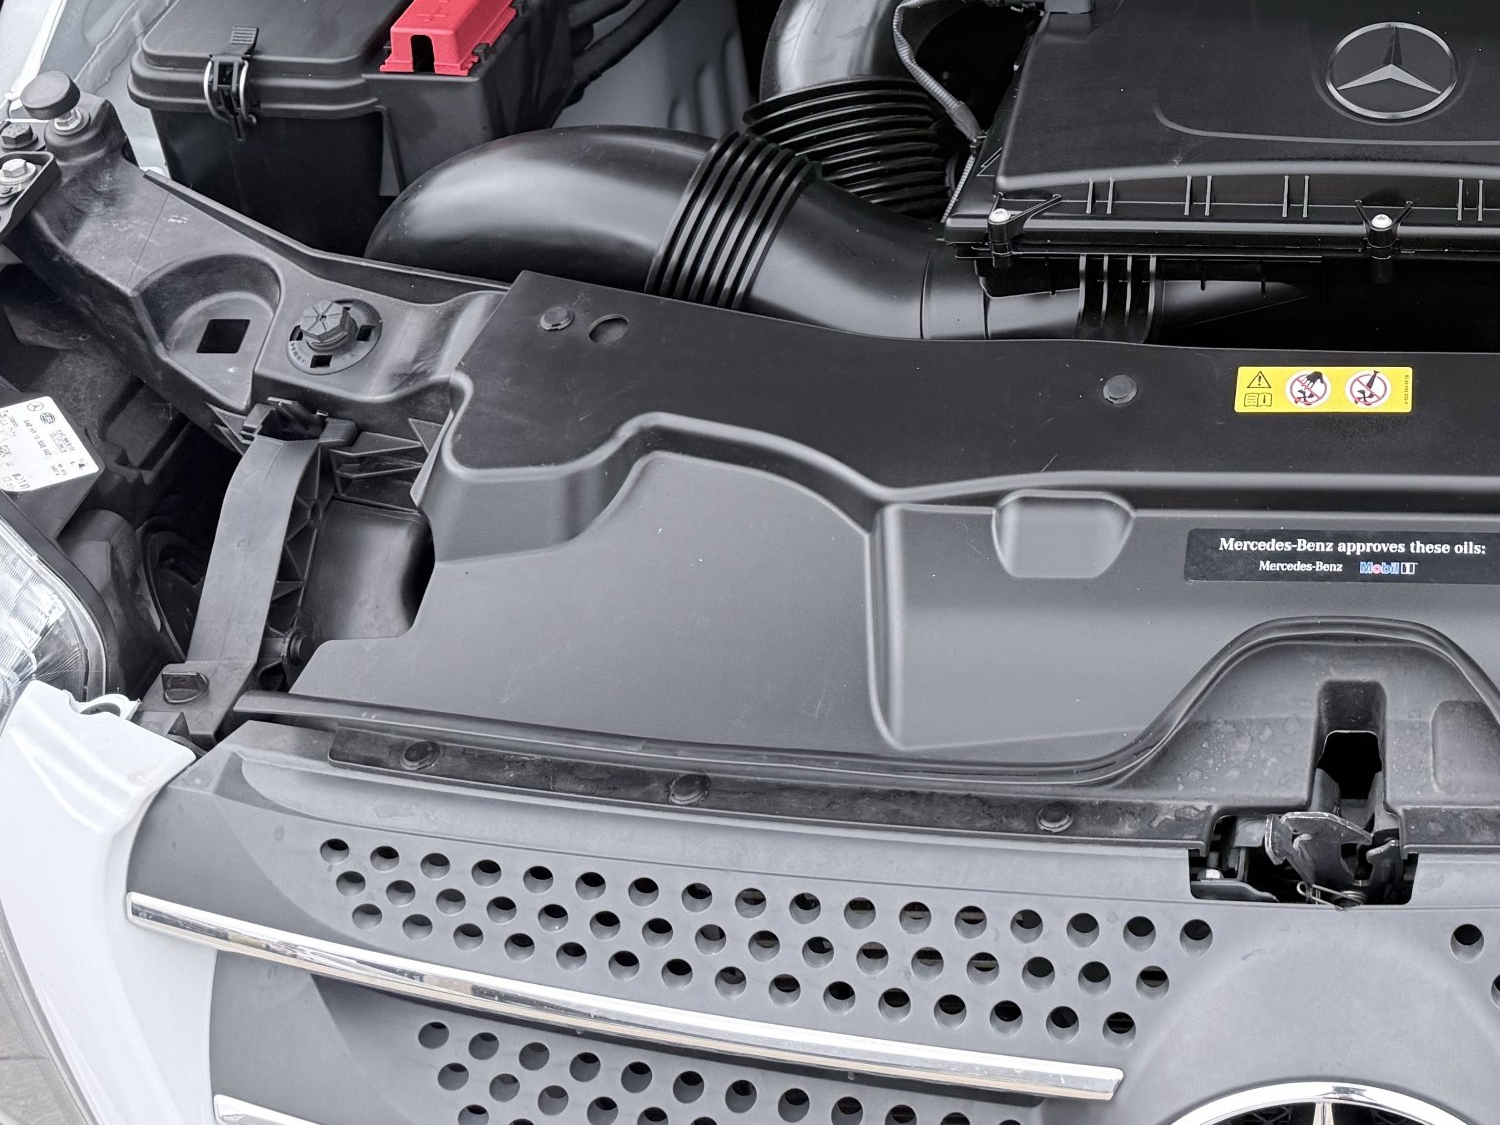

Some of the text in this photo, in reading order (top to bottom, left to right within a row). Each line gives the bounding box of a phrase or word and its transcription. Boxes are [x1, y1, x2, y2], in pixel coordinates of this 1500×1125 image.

[1220, 538, 1485, 555] Mercedes-Benz approves these oils:
[1259, 561, 1342, 571] Mercedes-Benz
[1360, 562, 1399, 574] Mobil
